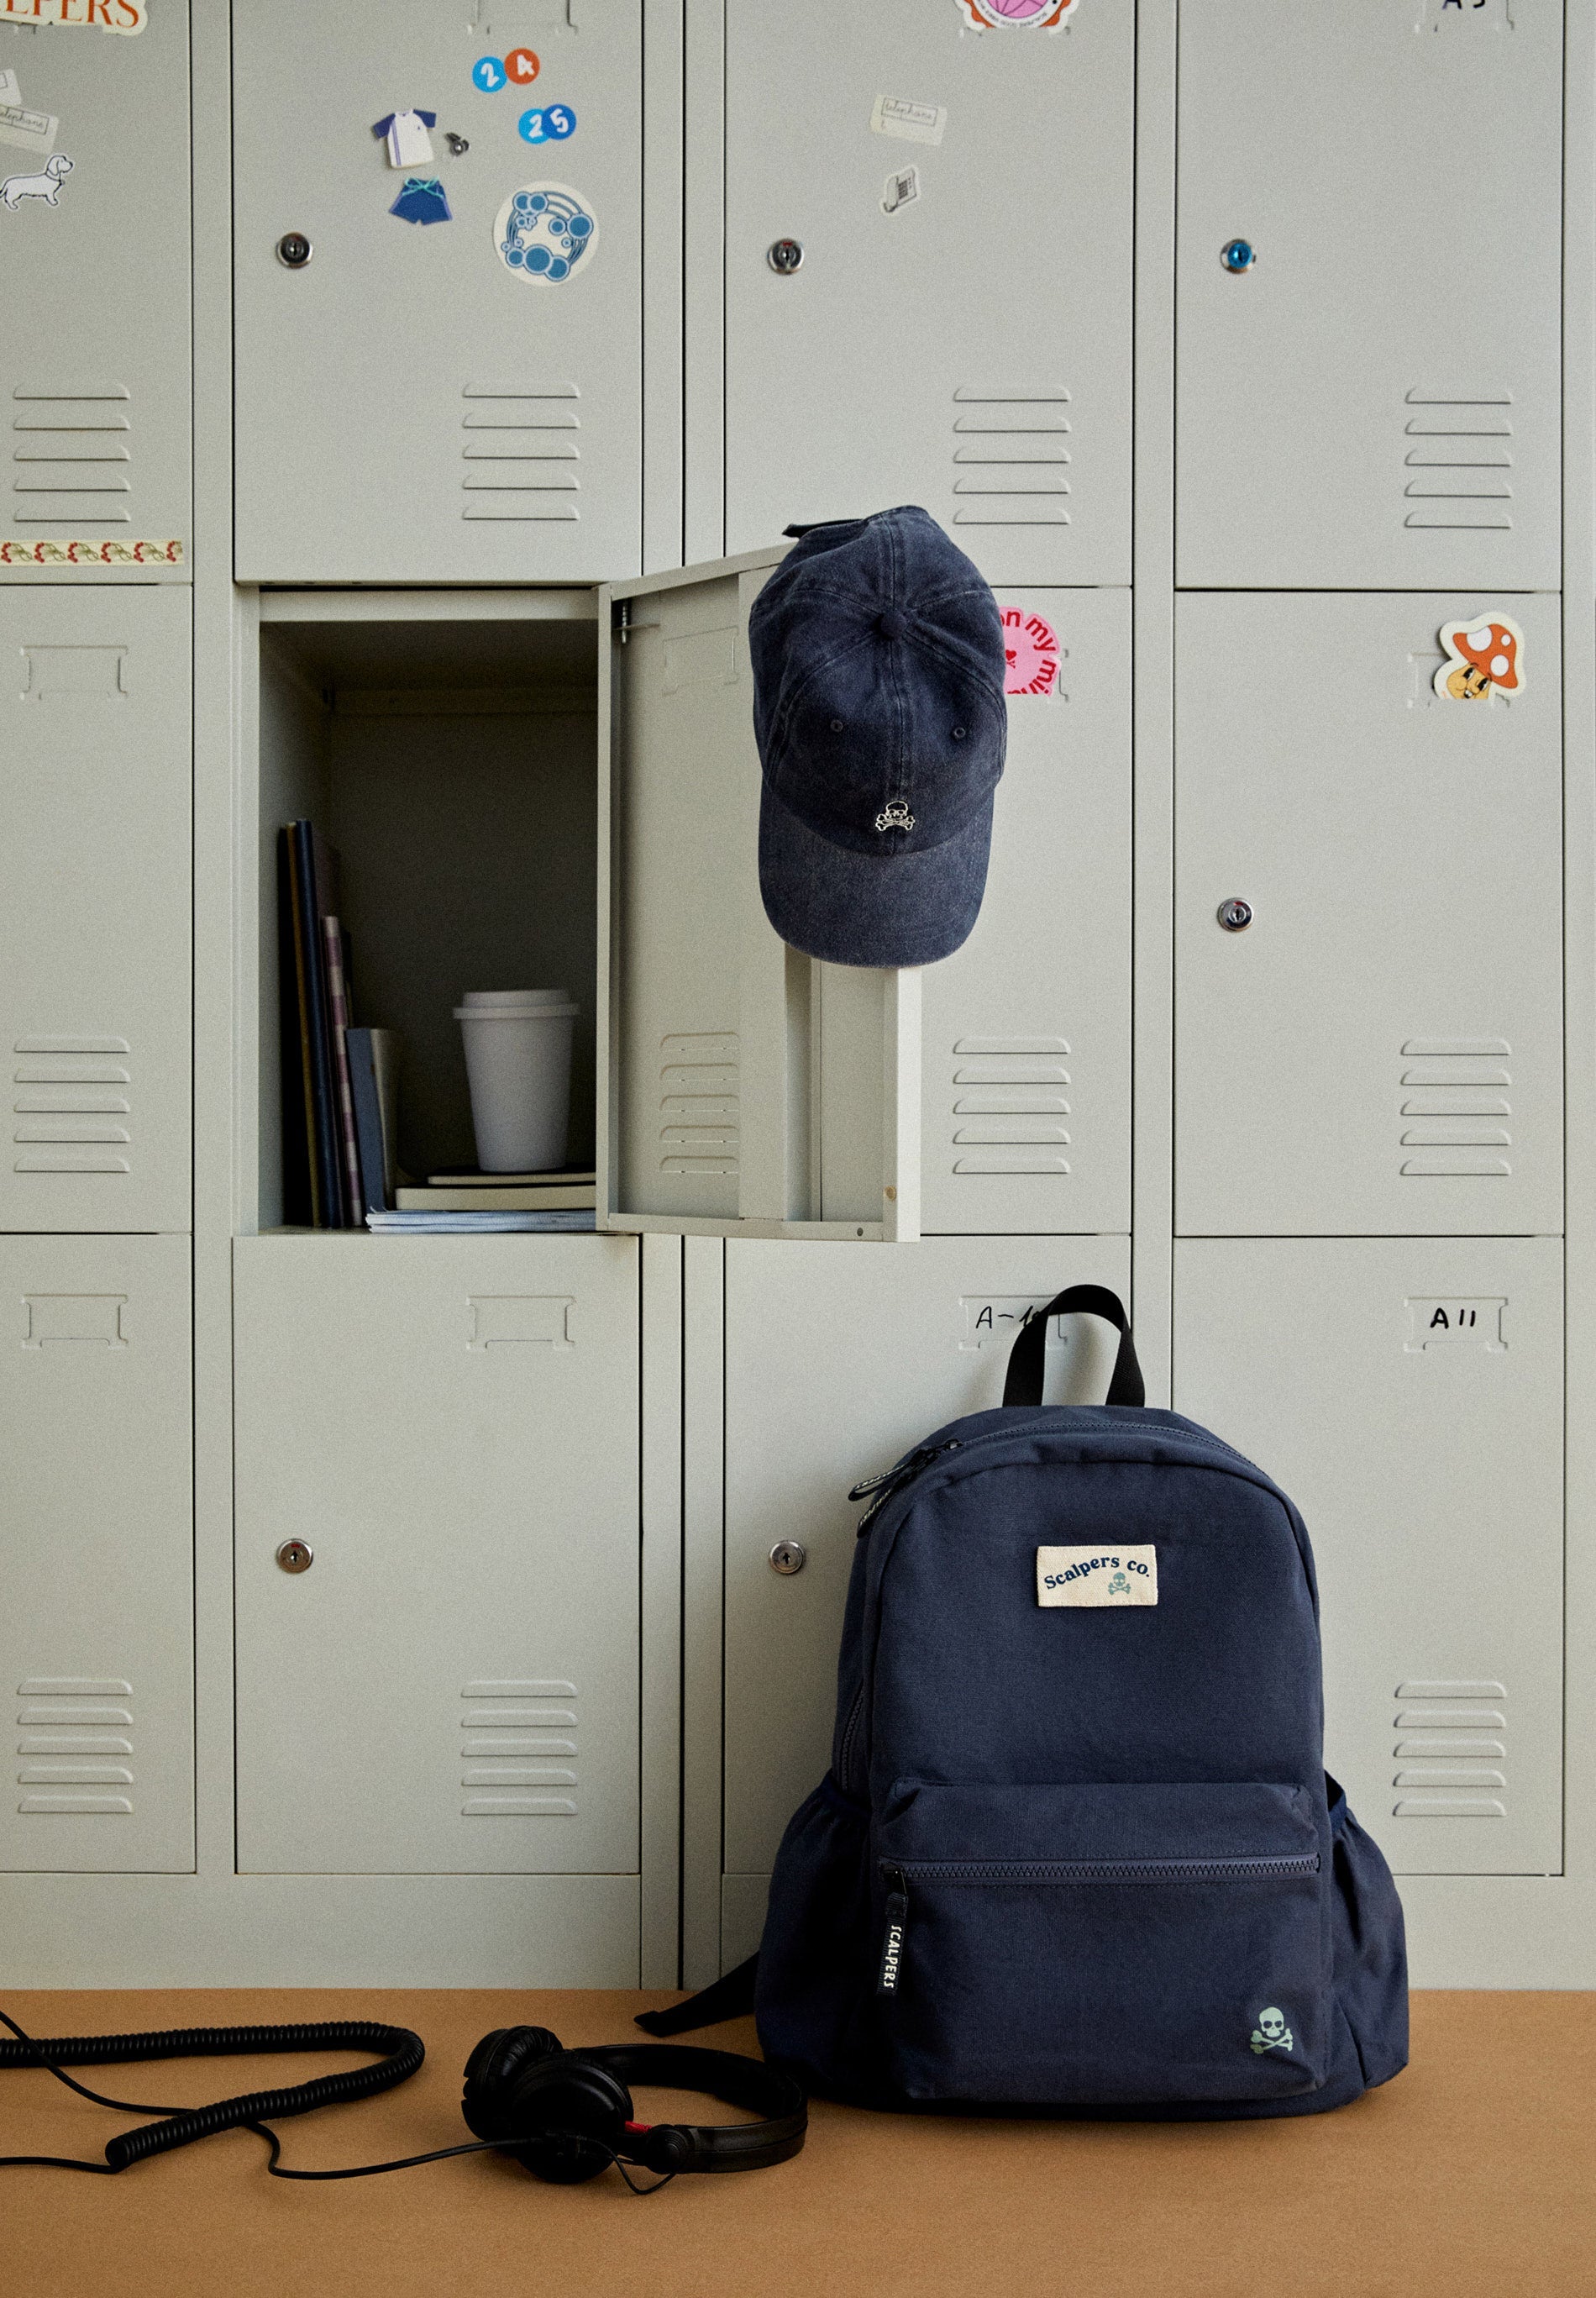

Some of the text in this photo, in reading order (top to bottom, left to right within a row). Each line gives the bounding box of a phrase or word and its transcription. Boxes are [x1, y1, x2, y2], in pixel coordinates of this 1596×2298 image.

[1025, 618, 1056, 651] my
[1044, 1557, 1150, 1590] Scalpers co.
[884, 1925, 902, 1989] SCALPERS
